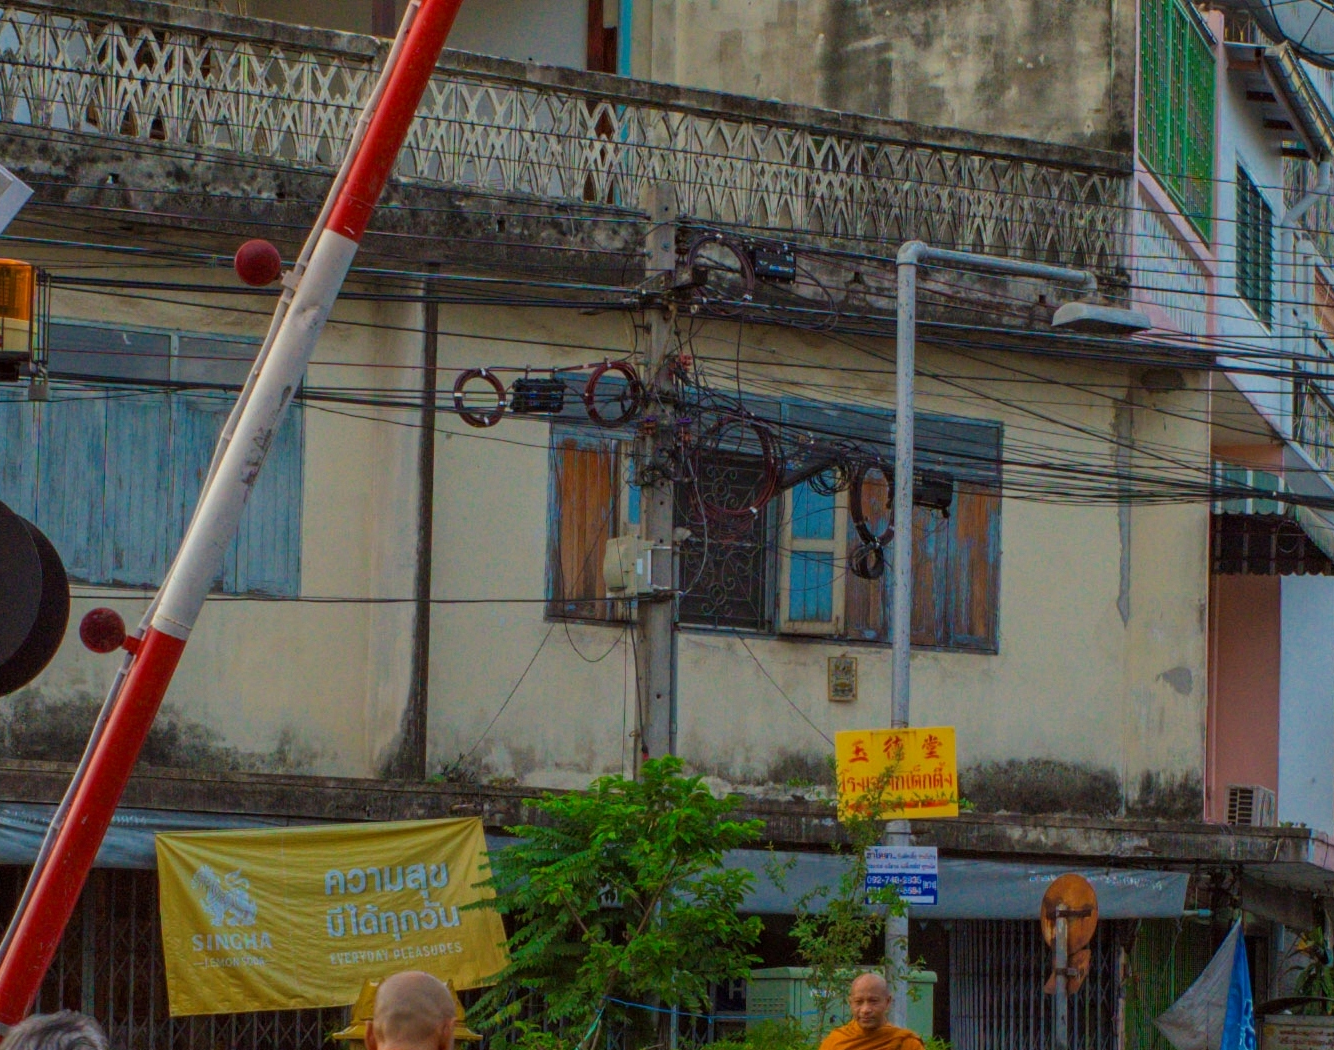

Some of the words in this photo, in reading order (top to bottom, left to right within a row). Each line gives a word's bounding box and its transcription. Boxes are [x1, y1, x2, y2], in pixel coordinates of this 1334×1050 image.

[324, 862, 449, 898] ความสุข
[326, 899, 461, 941] มีได้ทุกวัน
[192, 931, 273, 952] SINGHA
[330, 949, 388, 965] EVERYDAY
[393, 942, 463, 960] PLEASURES
